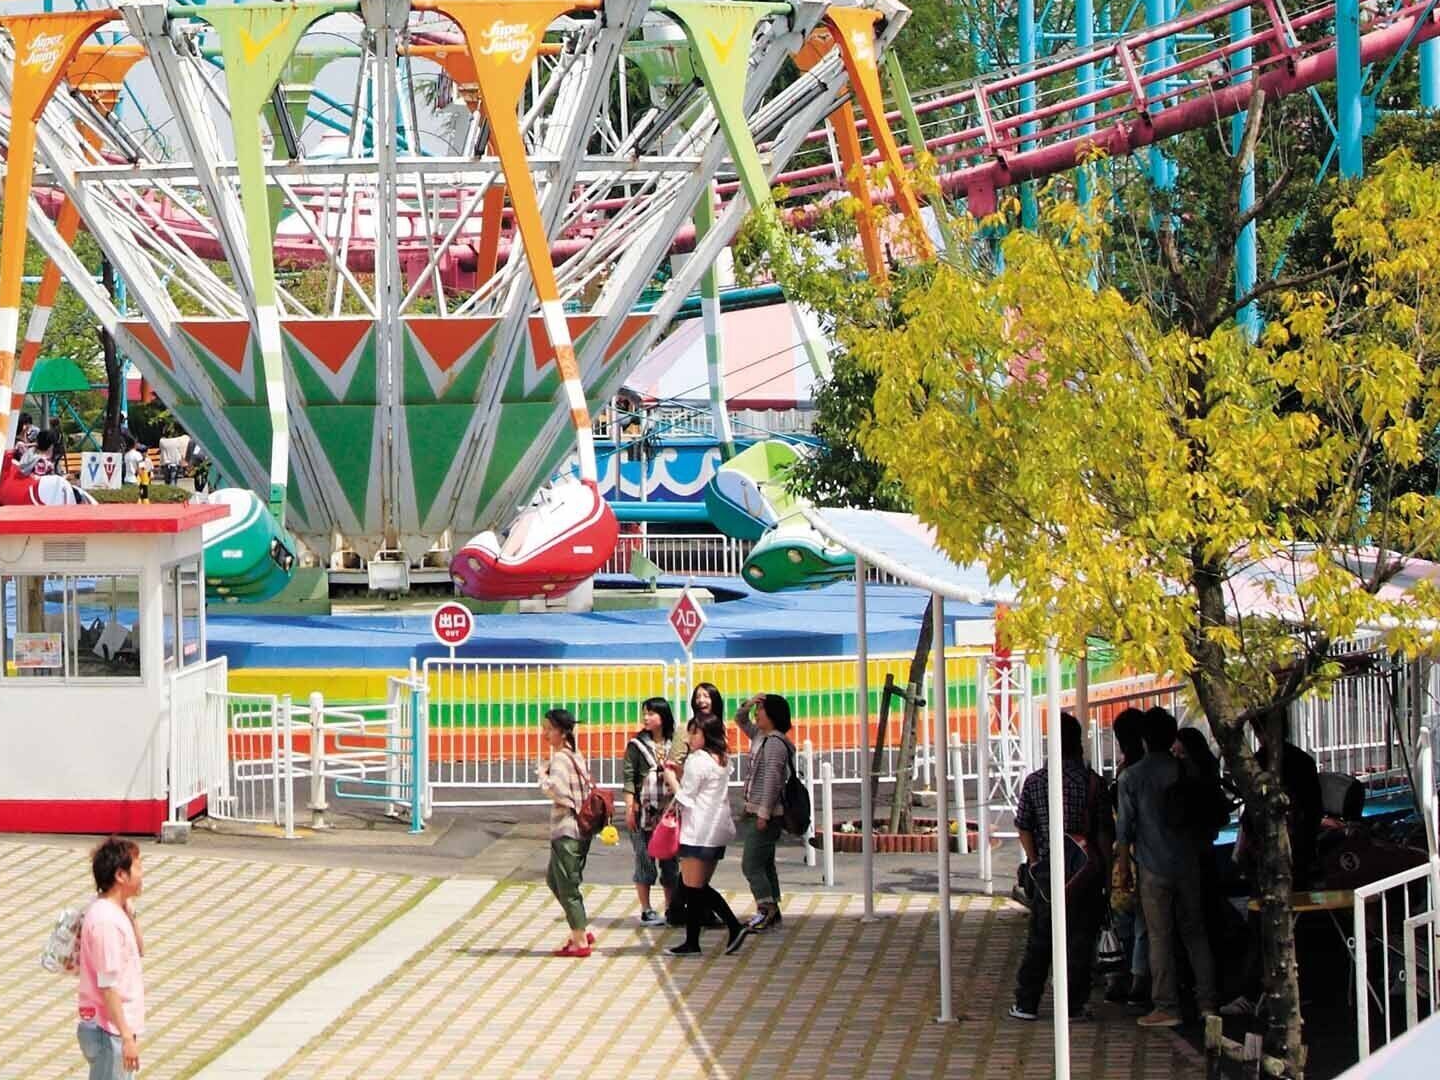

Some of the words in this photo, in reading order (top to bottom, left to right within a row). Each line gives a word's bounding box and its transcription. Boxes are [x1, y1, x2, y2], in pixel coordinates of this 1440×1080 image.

[481, 20, 528, 39] Super
[26, 32, 64, 51] Super
[439, 612, 466, 629] 出口
[676, 608, 697, 627] 入口
[445, 629, 460, 637] OUT
